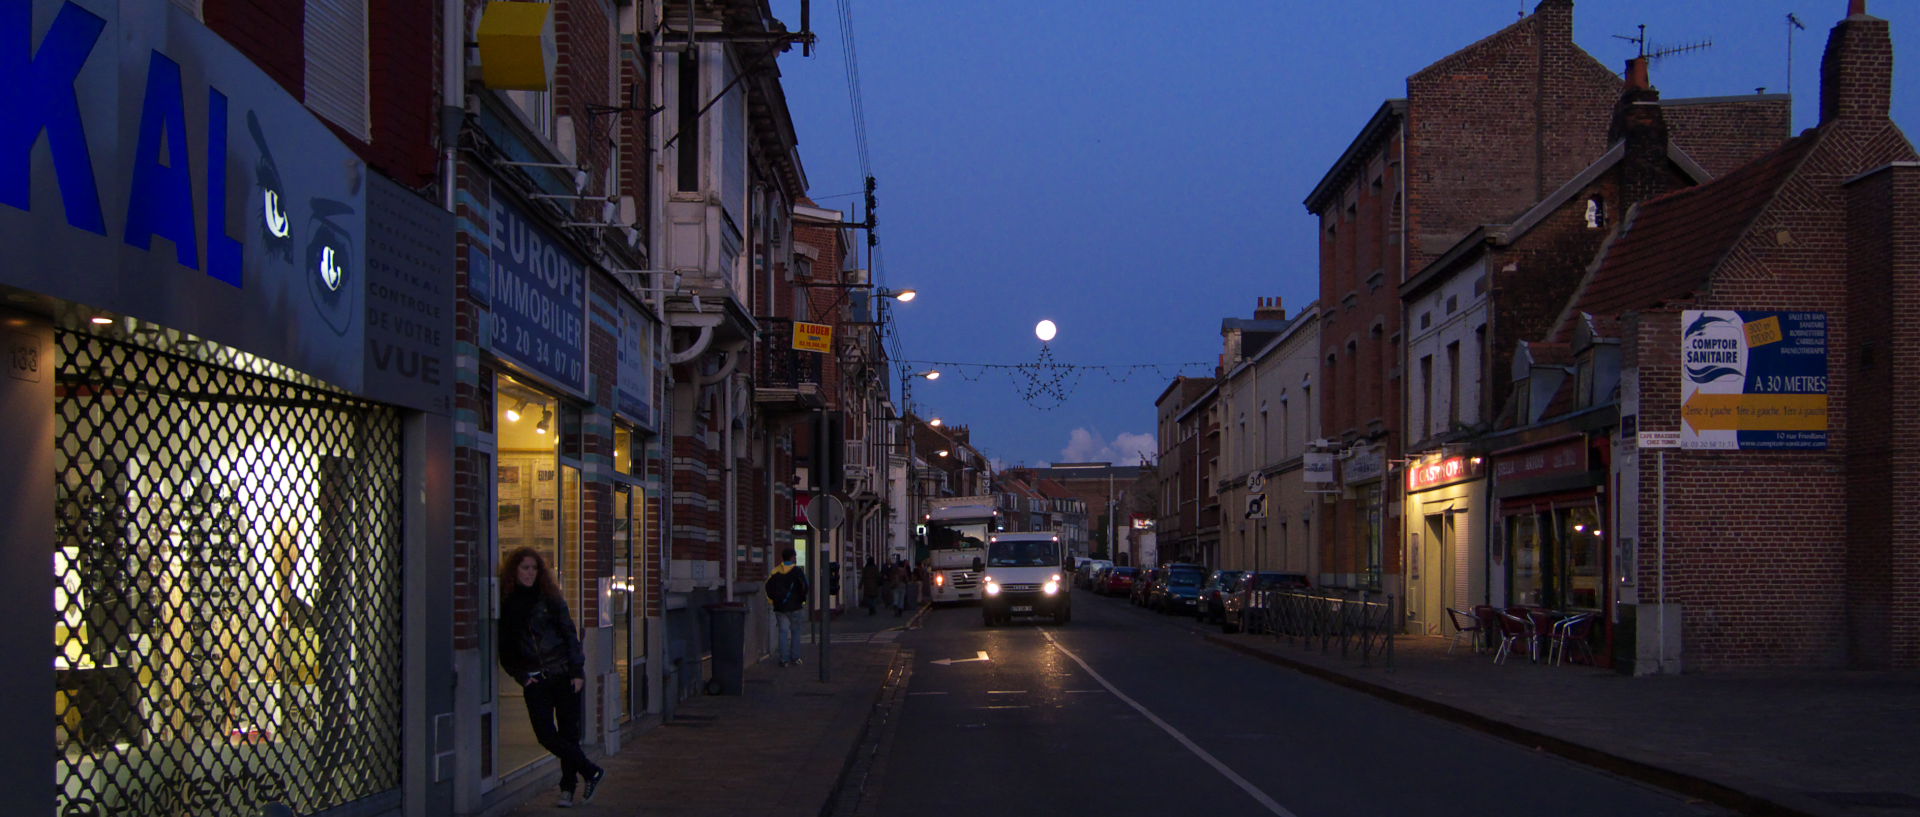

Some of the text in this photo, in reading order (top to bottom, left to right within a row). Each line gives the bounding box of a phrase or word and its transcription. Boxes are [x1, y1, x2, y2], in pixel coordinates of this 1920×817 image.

[491, 196, 582, 309] EUROPE
[369, 258, 440, 295] OPTIKAL
[369, 282, 440, 318] CONTROLE
[491, 259, 581, 350] IMMOBILIER
[369, 308, 440, 347] DE VOTRE
[800, 324, 830, 336] A LOUER
[1692, 339, 1737, 349] COMPTOIR
[370, 339, 440, 386] VUE
[492, 312, 582, 382] 03 20 34 07 07
[1687, 351, 1737, 363] SANITAIRE
[1754, 376, 1826, 392] A 30 METRES
[1250, 477, 1261, 486] 30
